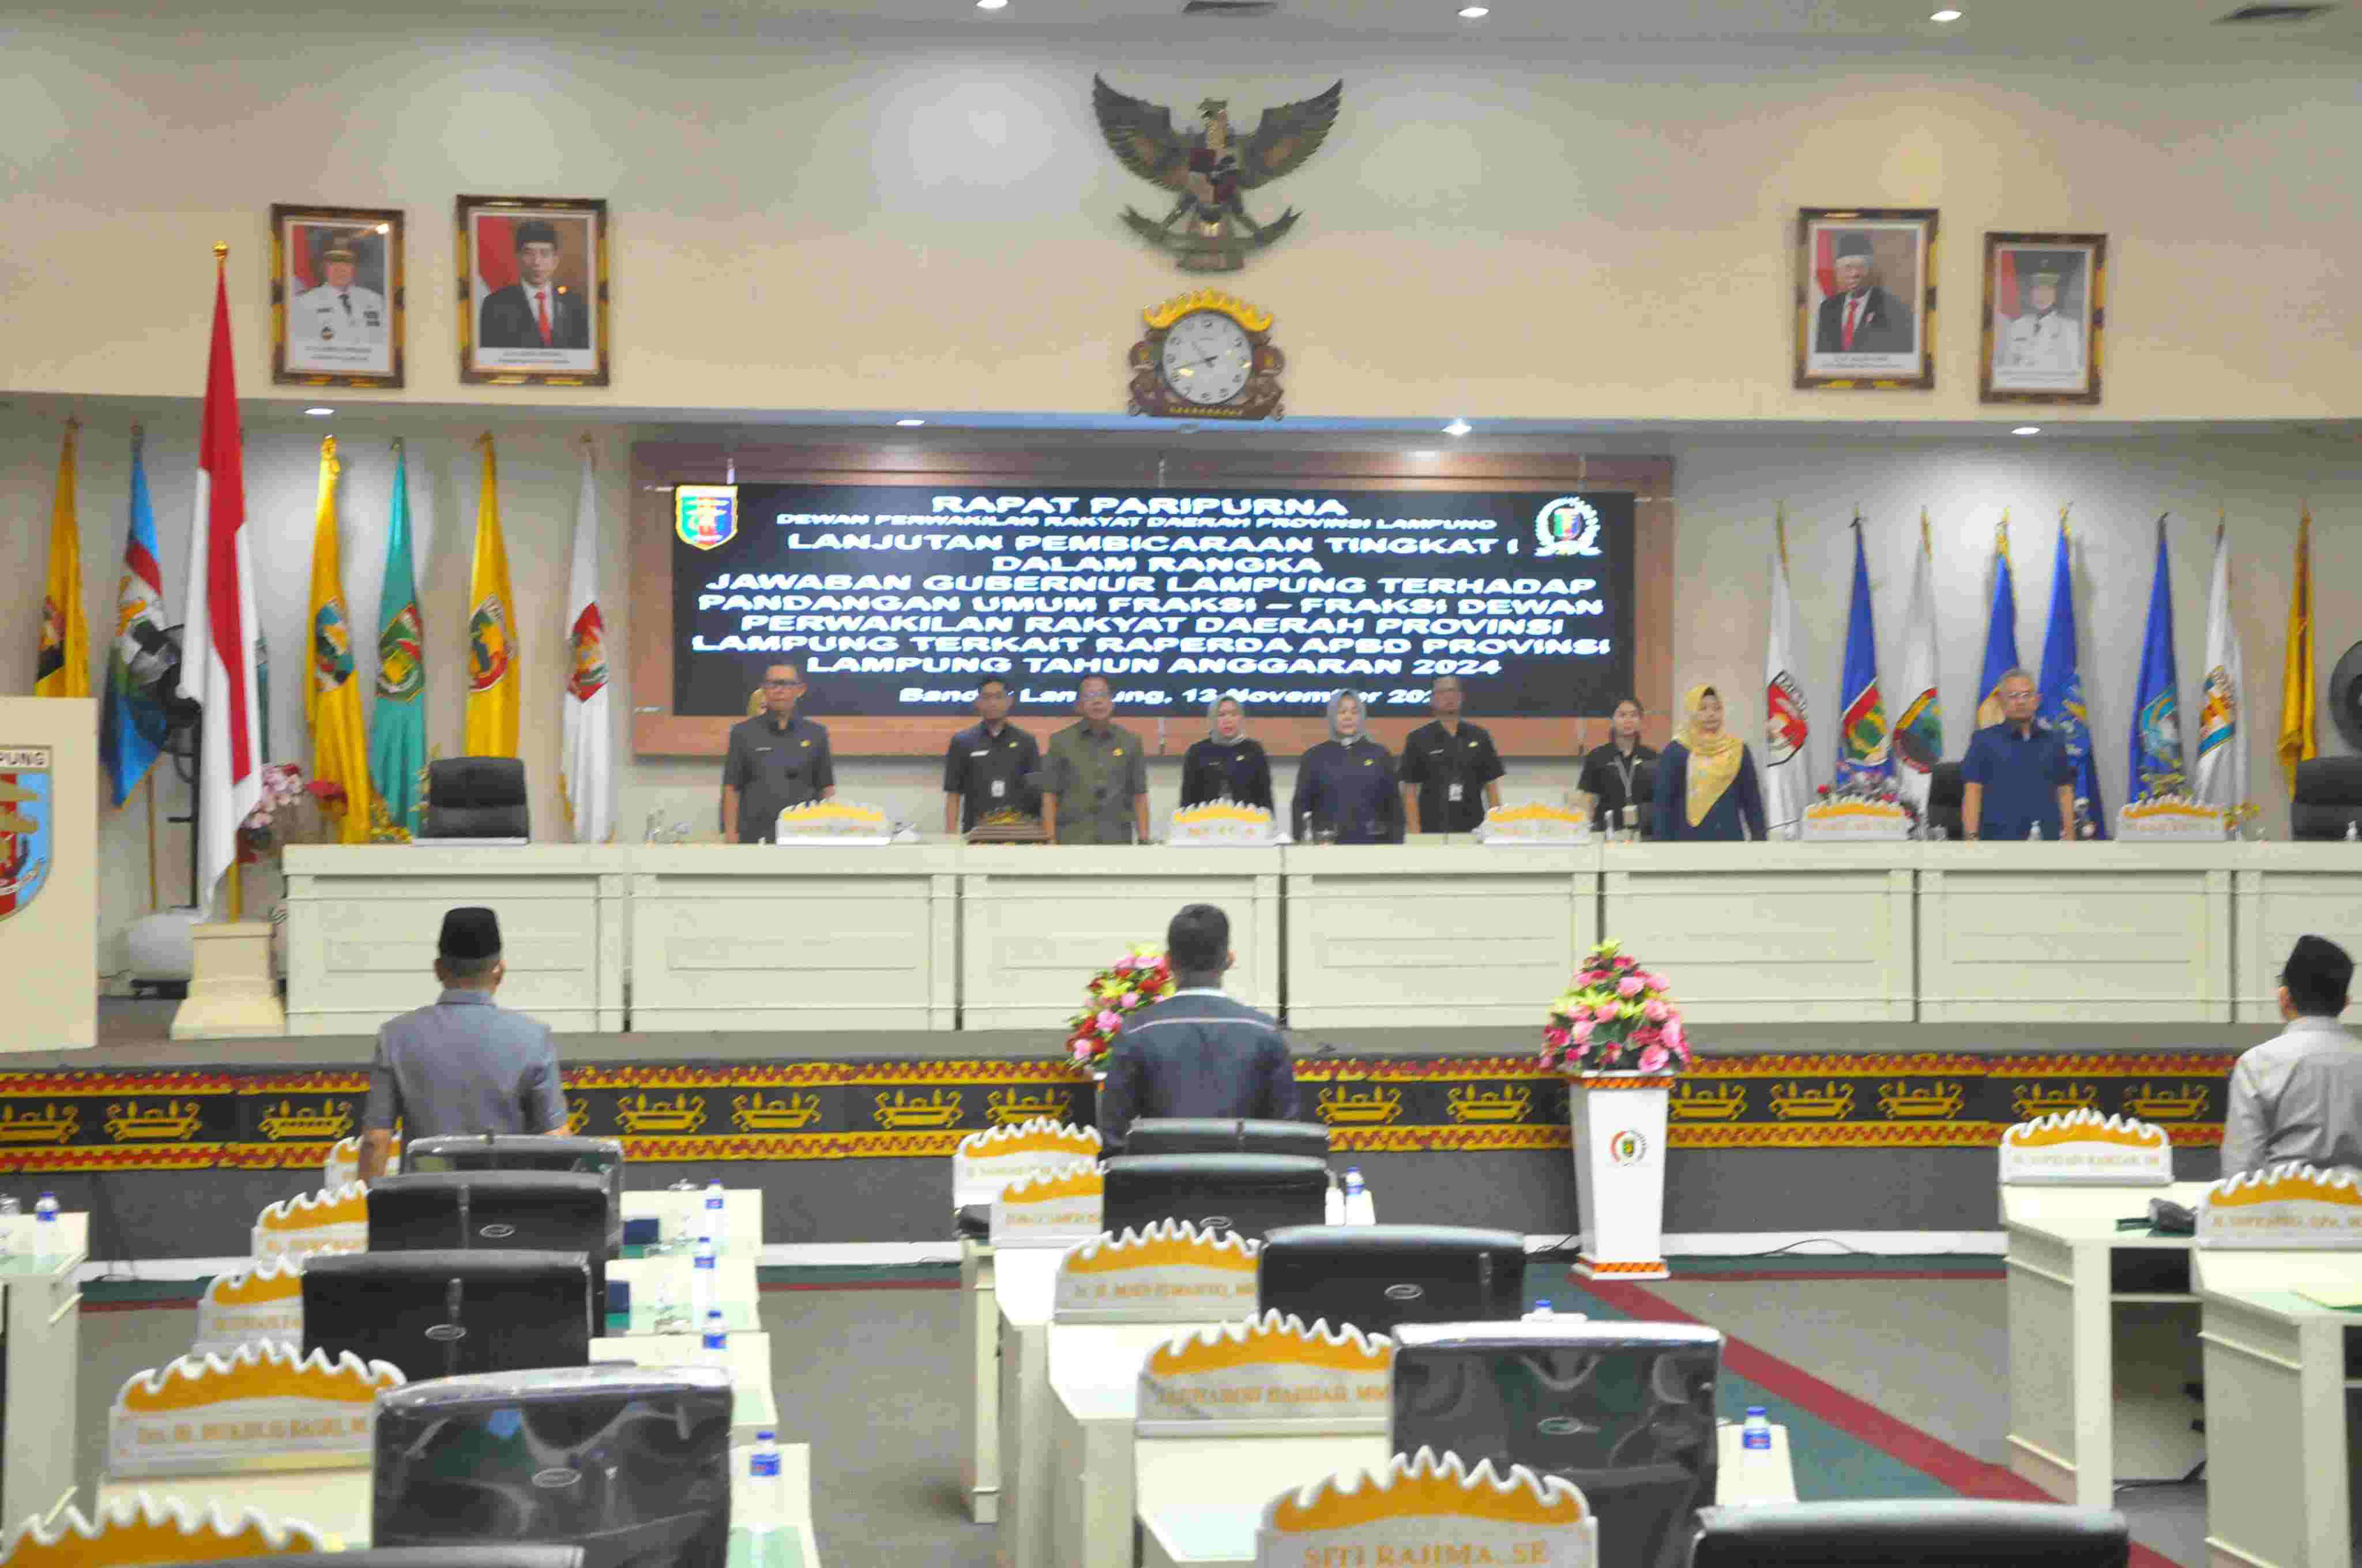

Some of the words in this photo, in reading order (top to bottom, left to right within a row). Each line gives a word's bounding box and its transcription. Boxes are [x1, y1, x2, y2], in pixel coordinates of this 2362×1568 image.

[932, 496, 1079, 514] RAPAT
[1090, 497, 1349, 515] PARIPURNA
[788, 533, 1003, 551] LANJUTAN
[1015, 535, 1314, 552] PEMBICARAAN
[1324, 537, 1499, 554] TINGKAT
[1506, 539, 1519, 554] I
[991, 556, 1137, 572] DALAM
[1148, 557, 1323, 573] RANGKA
[705, 573, 913, 591] JAWABAN
[923, 574, 1156, 592] GUBERNUR
[1166, 577, 1366, 593] LAMPUNG
[1377, 577, 1596, 595] TERHADAP
[698, 595, 961, 611] PANDANGAN
[972, 596, 1097, 612] UMUM
[1108, 597, 1257, 614] FRAKSI
[1300, 597, 1447, 614] FRAKSI
[1457, 599, 1603, 615] DEWAN
[740, 615, 1013, 632] PERWAKILAN
[1024, 616, 1187, 633] RAKYAT
[1195, 616, 1364, 634] DAERAH
[1375, 618, 1564, 635] PROVINSI
[692, 635, 900, 652] LAMPUNG
[909, 636, 1086, 652] TERKAIT
[1095, 637, 1293, 653] RAPERDA
[1298, 637, 1412, 654] APBD
[1422, 638, 1610, 655] PROVINSI
[806, 656, 1011, 673] LAMPUNG
[1022, 657, 1159, 674] TAHUN
[1167, 657, 1402, 675] ANGGARAN
[1411, 659, 1502, 675] 2024
[899, 687, 1014, 703] Band
[1019, 688, 1172, 704] Lamung,
[1224, 688, 1383, 704] Novemer
